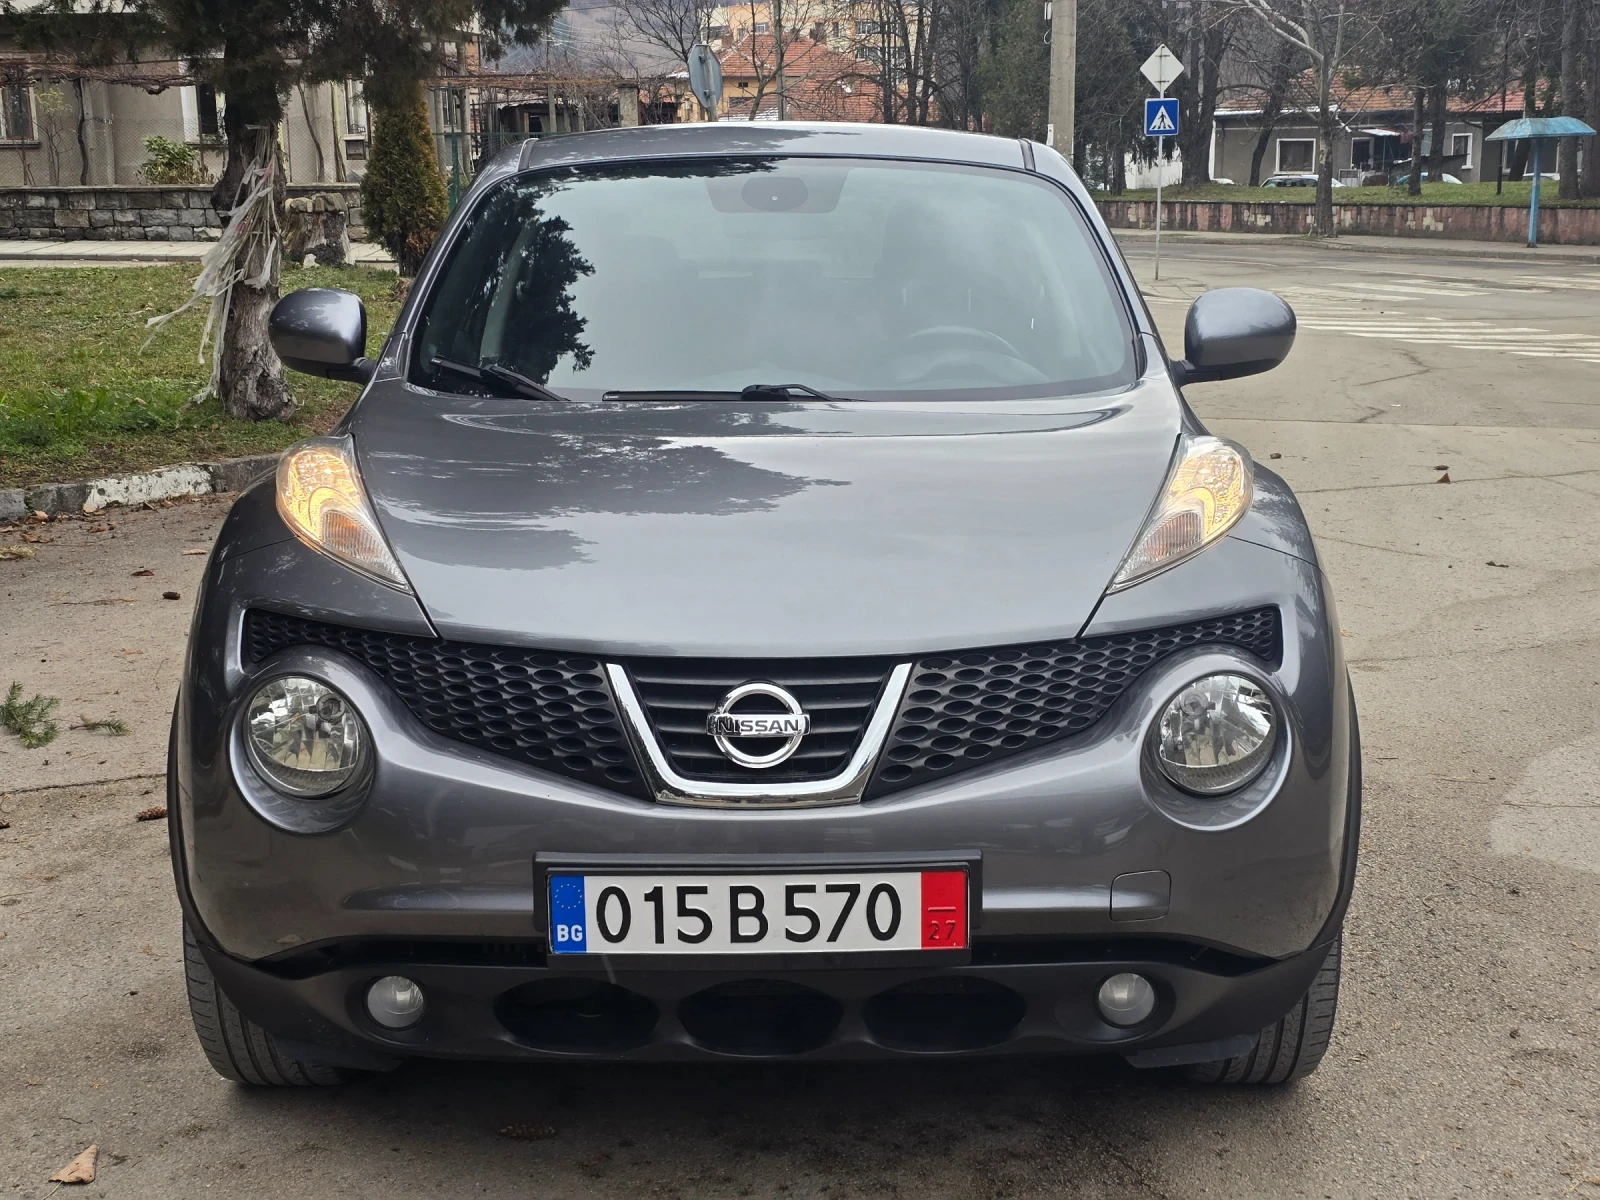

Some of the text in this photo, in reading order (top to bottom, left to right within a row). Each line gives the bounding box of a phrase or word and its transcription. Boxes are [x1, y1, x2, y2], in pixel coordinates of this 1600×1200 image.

[717, 717, 799, 733] NISSAN
[557, 924, 583, 942] BG
[929, 920, 956, 941] 27
